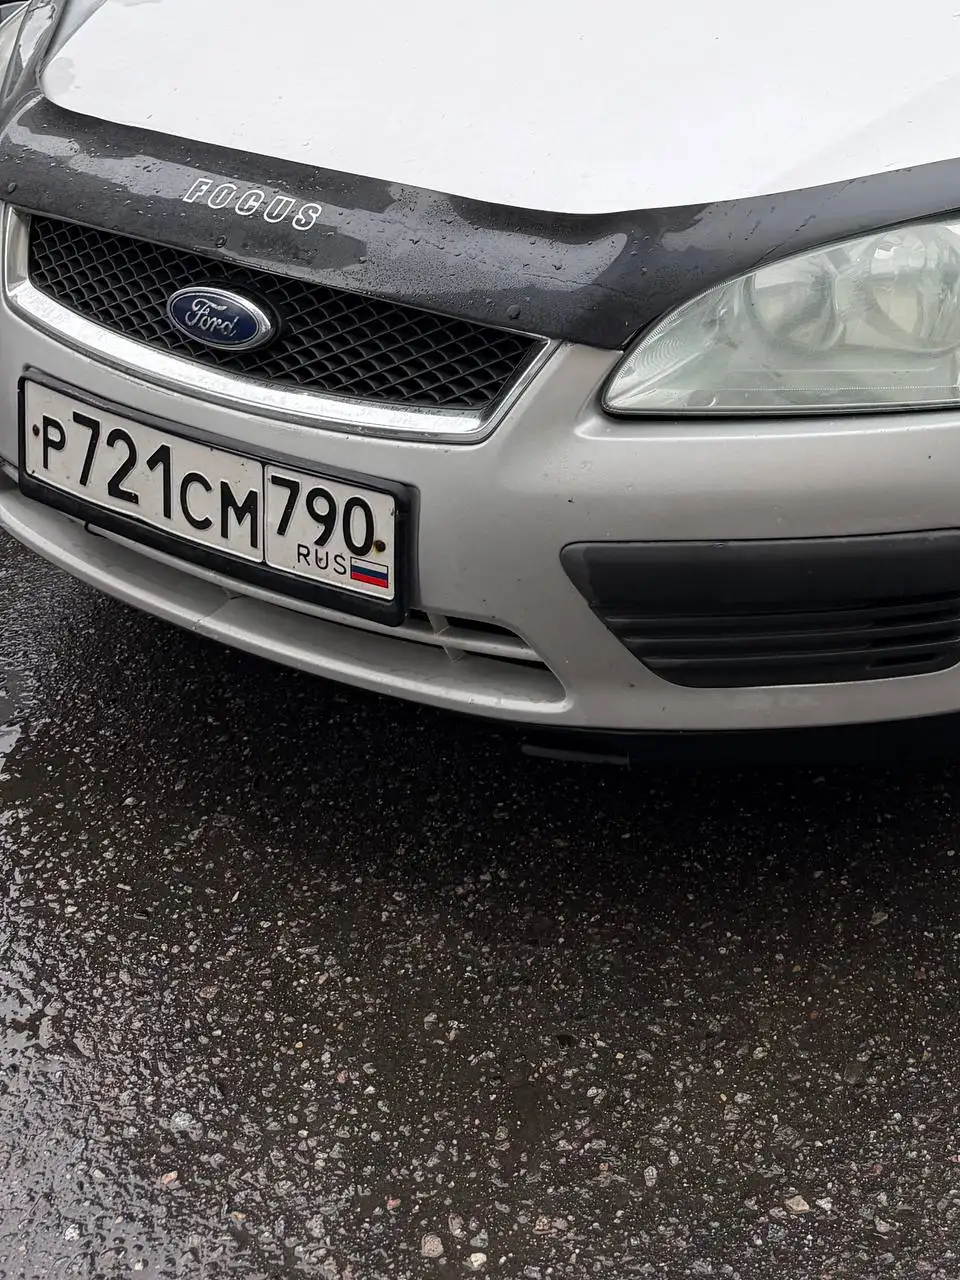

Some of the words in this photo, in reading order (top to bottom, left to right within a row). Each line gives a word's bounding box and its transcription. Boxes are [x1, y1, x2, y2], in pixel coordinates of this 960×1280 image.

[183, 178, 322, 230] FOCUS
[184, 298, 237, 338] Ford
[270, 475, 375, 557] 790
[297, 543, 347, 576] RUS
